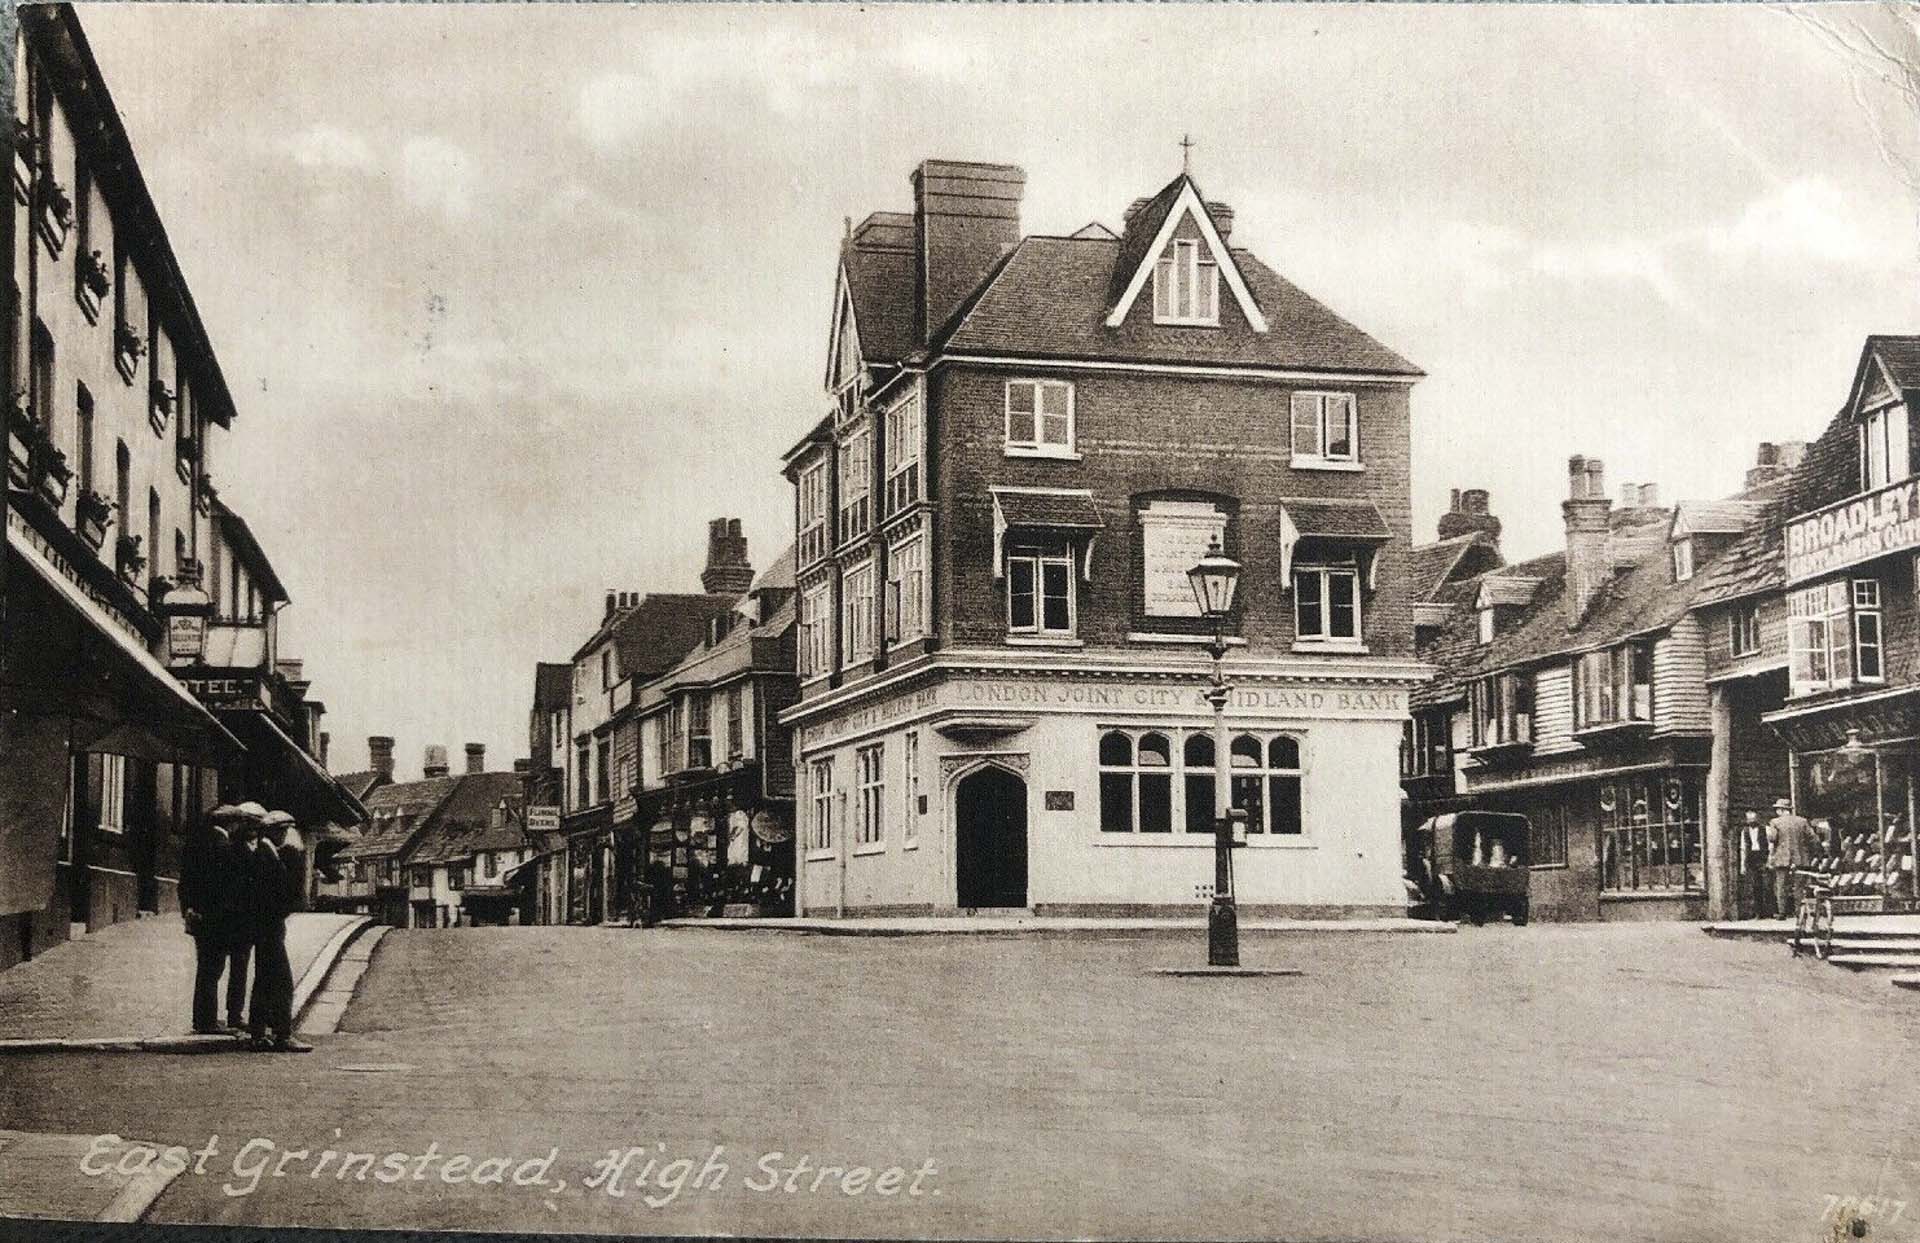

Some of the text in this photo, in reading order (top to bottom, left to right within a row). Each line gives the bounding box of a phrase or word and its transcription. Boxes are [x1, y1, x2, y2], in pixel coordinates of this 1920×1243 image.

[1789, 483, 1914, 556] BROADLEY
[957, 684, 1049, 703] LONDON
[1057, 687, 1123, 704] JOINT
[1133, 688, 1185, 706] CITY
[1337, 693, 1400, 711] BANK
